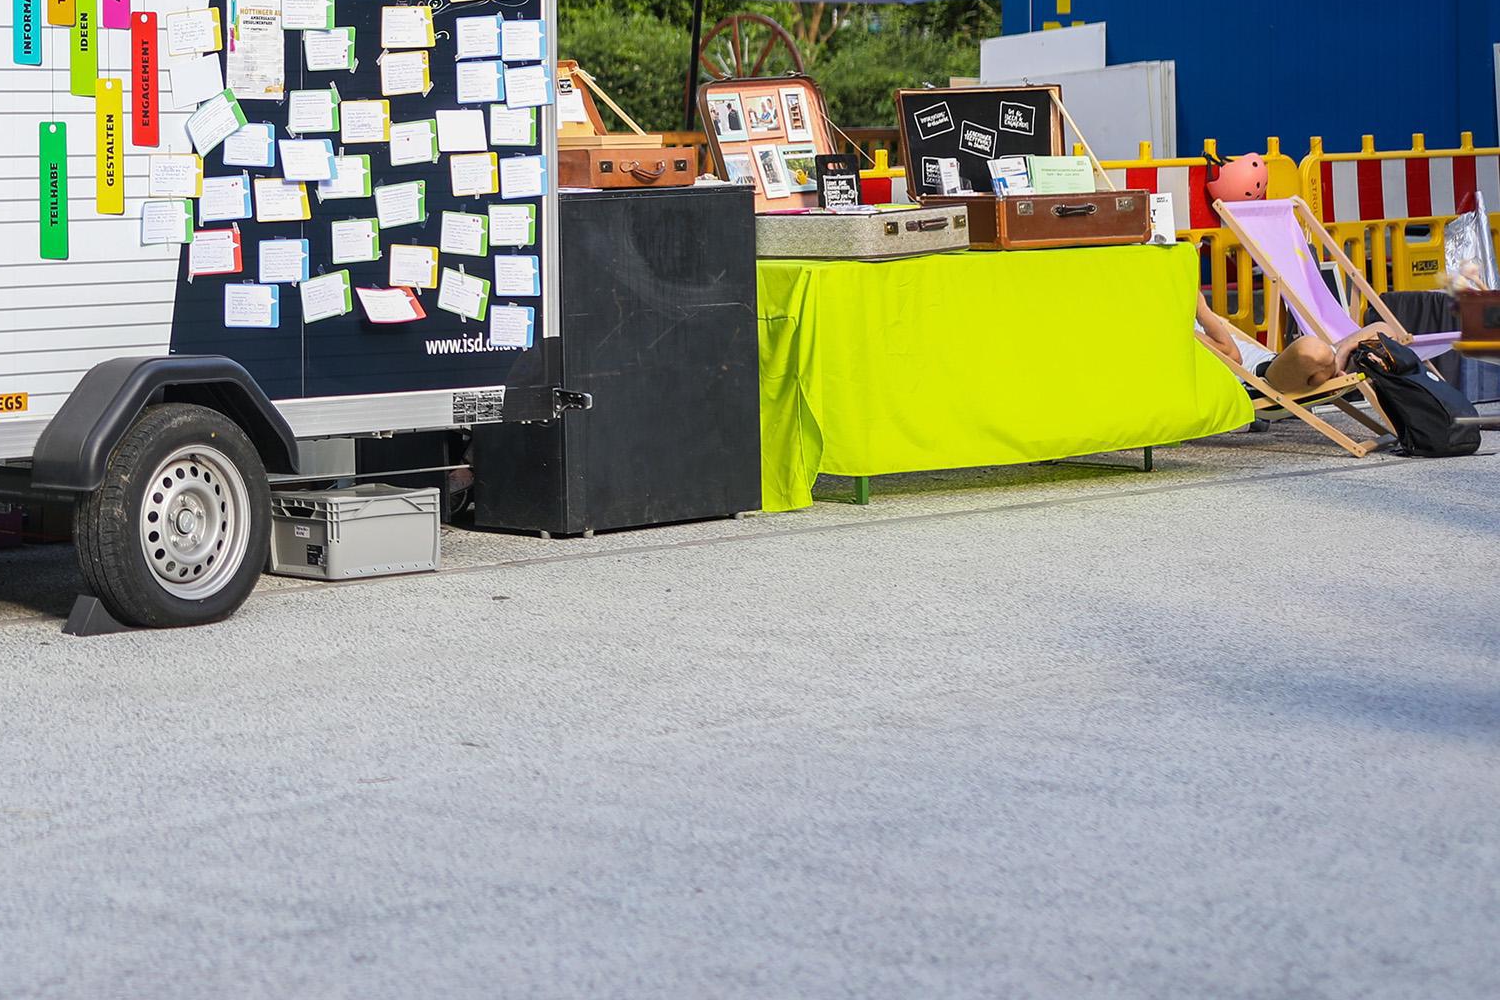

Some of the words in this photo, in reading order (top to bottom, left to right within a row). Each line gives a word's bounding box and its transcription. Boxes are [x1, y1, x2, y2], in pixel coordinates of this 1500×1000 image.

[80, 12, 88, 52] IDEEN
[142, 39, 150, 127] ENGAGEMENT
[106, 114, 115, 187] GESTALTEN
[50, 162, 59, 227] TEILHABE
